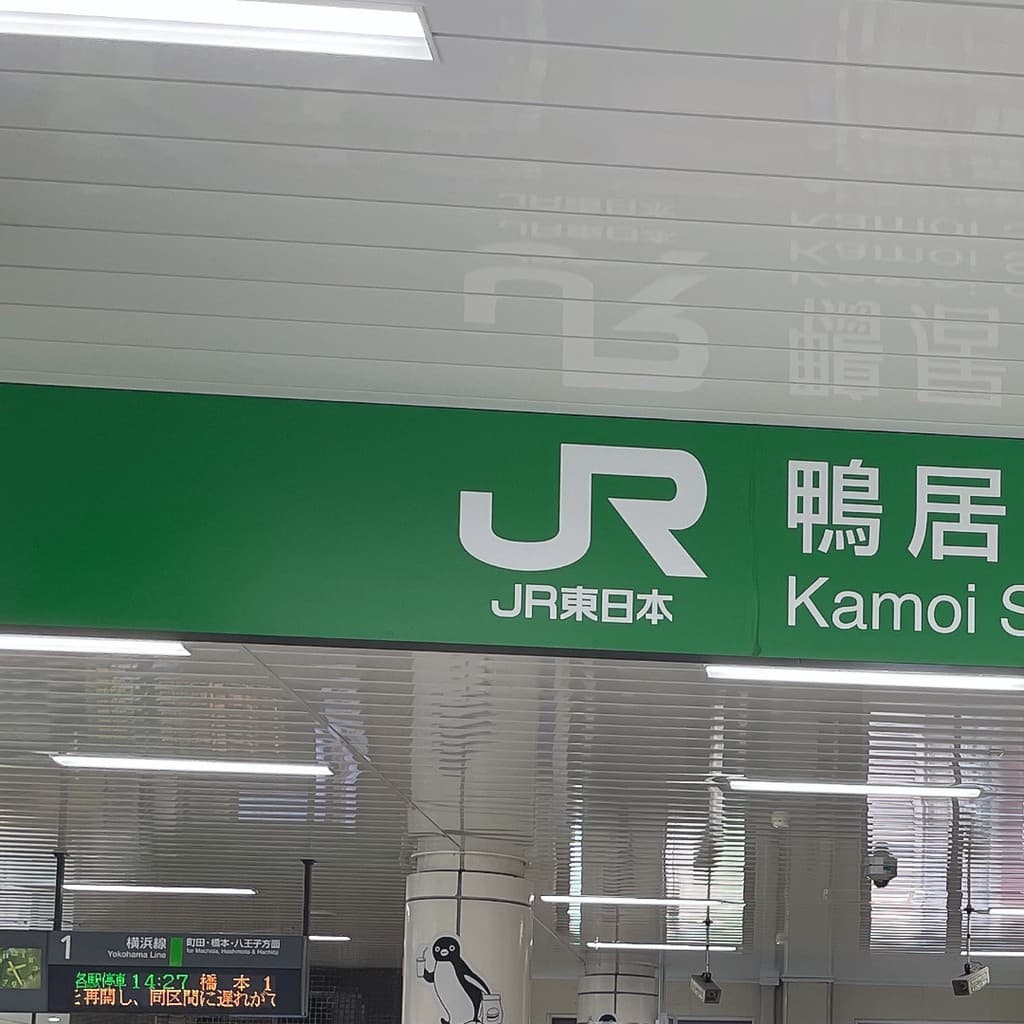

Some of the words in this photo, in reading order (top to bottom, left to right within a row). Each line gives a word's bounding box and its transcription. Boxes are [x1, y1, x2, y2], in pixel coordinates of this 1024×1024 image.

[458, 443, 709, 579] JR
[491, 583, 674, 625] JR東日本
[786, 575, 976, 634] Kamoi
[60, 935, 71, 960] 1
[107, 950, 147, 960] Yokohama
[150, 951, 167, 959] Line
[126, 936, 167, 950] 横浜線
[75, 972, 127, 988] 各駅停車
[132, 974, 189, 990] 14:27
[263, 975, 272, 991] 1
